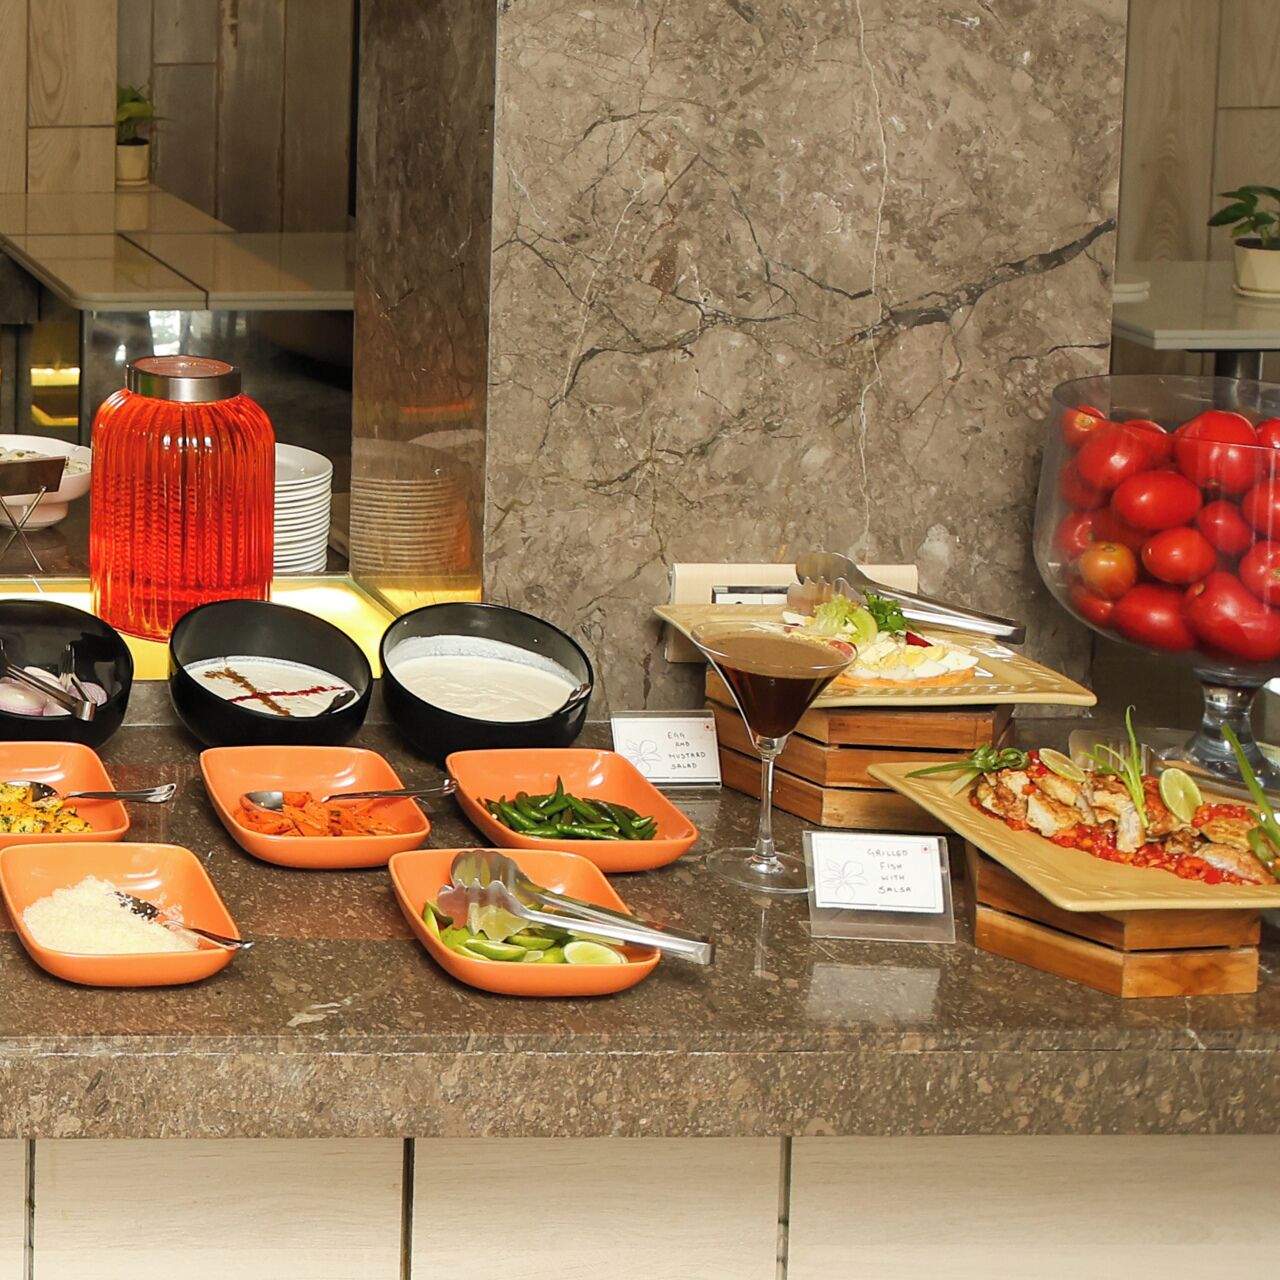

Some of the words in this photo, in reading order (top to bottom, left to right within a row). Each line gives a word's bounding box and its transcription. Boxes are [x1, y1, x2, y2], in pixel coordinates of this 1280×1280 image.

[668, 751, 706, 760] MUSTARD
[670, 762, 697, 770] SALAD
[867, 848, 909, 857] GRILLED
[879, 861, 903, 870] FISH
[877, 886, 912, 894] SALSA
